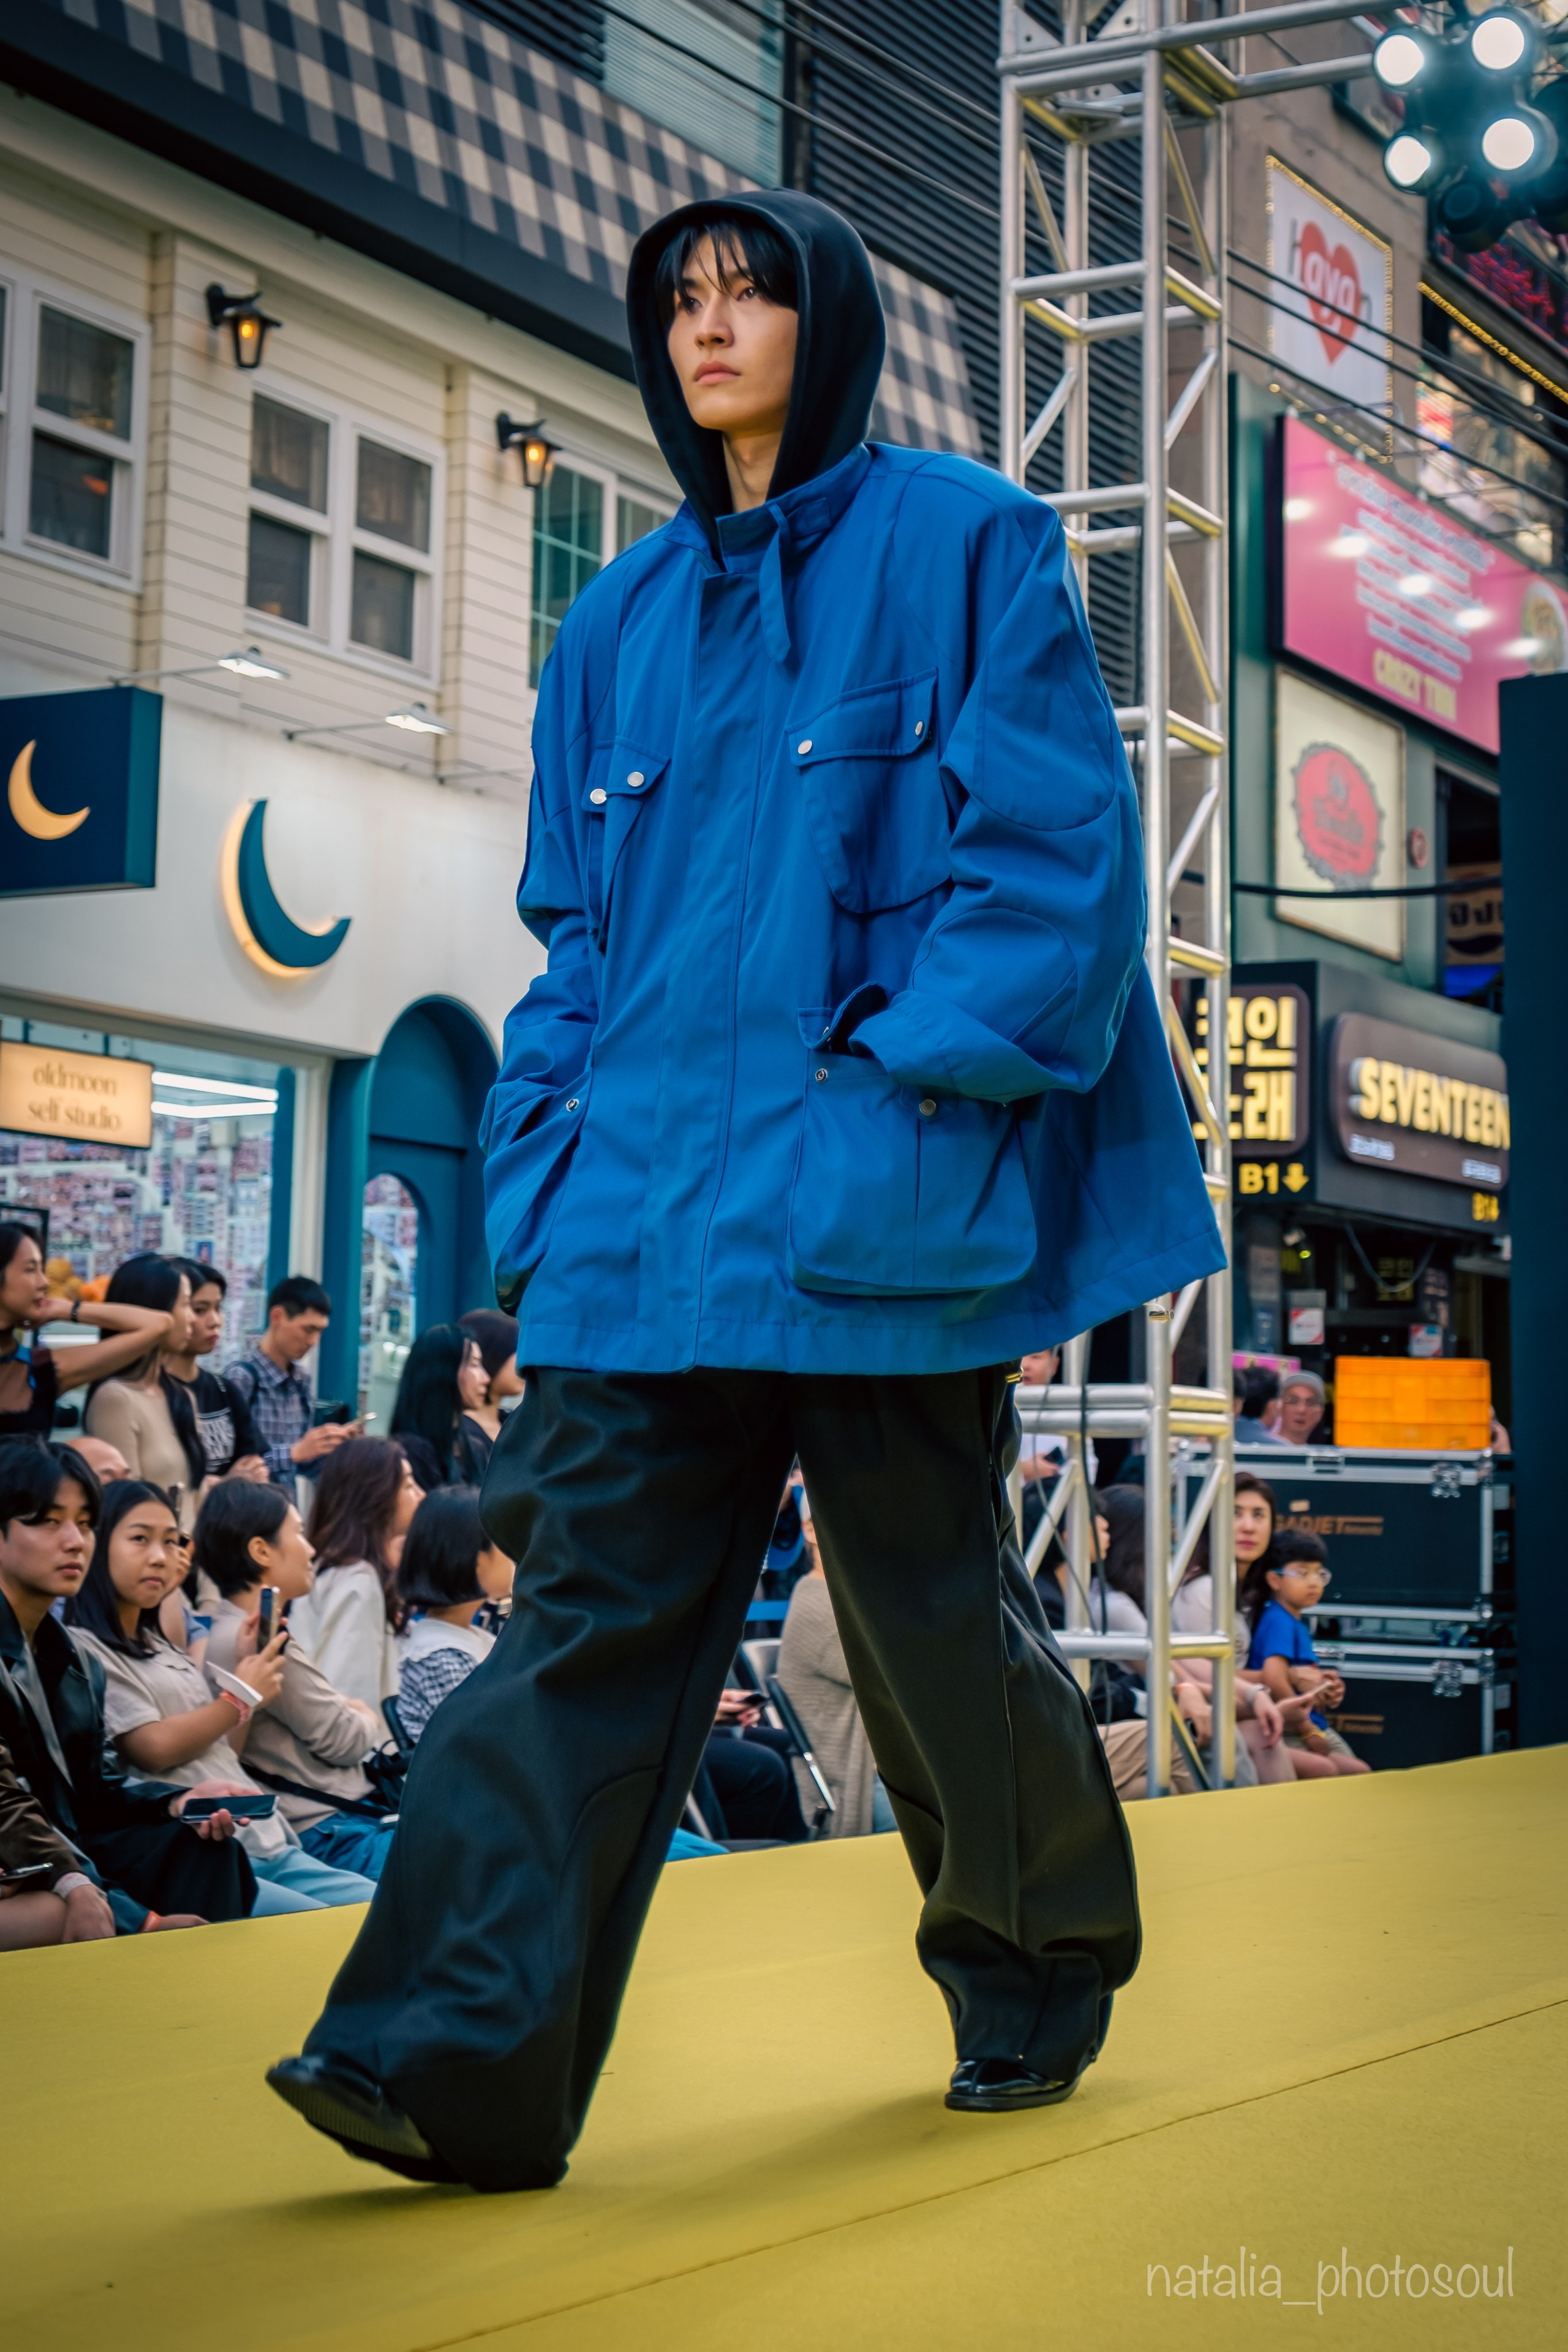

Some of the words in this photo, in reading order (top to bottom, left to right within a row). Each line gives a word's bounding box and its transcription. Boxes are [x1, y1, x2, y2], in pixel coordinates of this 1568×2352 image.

[33, 1061, 118, 1096] oldmoon
[29, 1096, 62, 1124] self
[65, 1104, 122, 1131] studio
[1357, 1057, 1510, 1151] SEVENTEEN
[1238, 1163, 1280, 1194] B1
